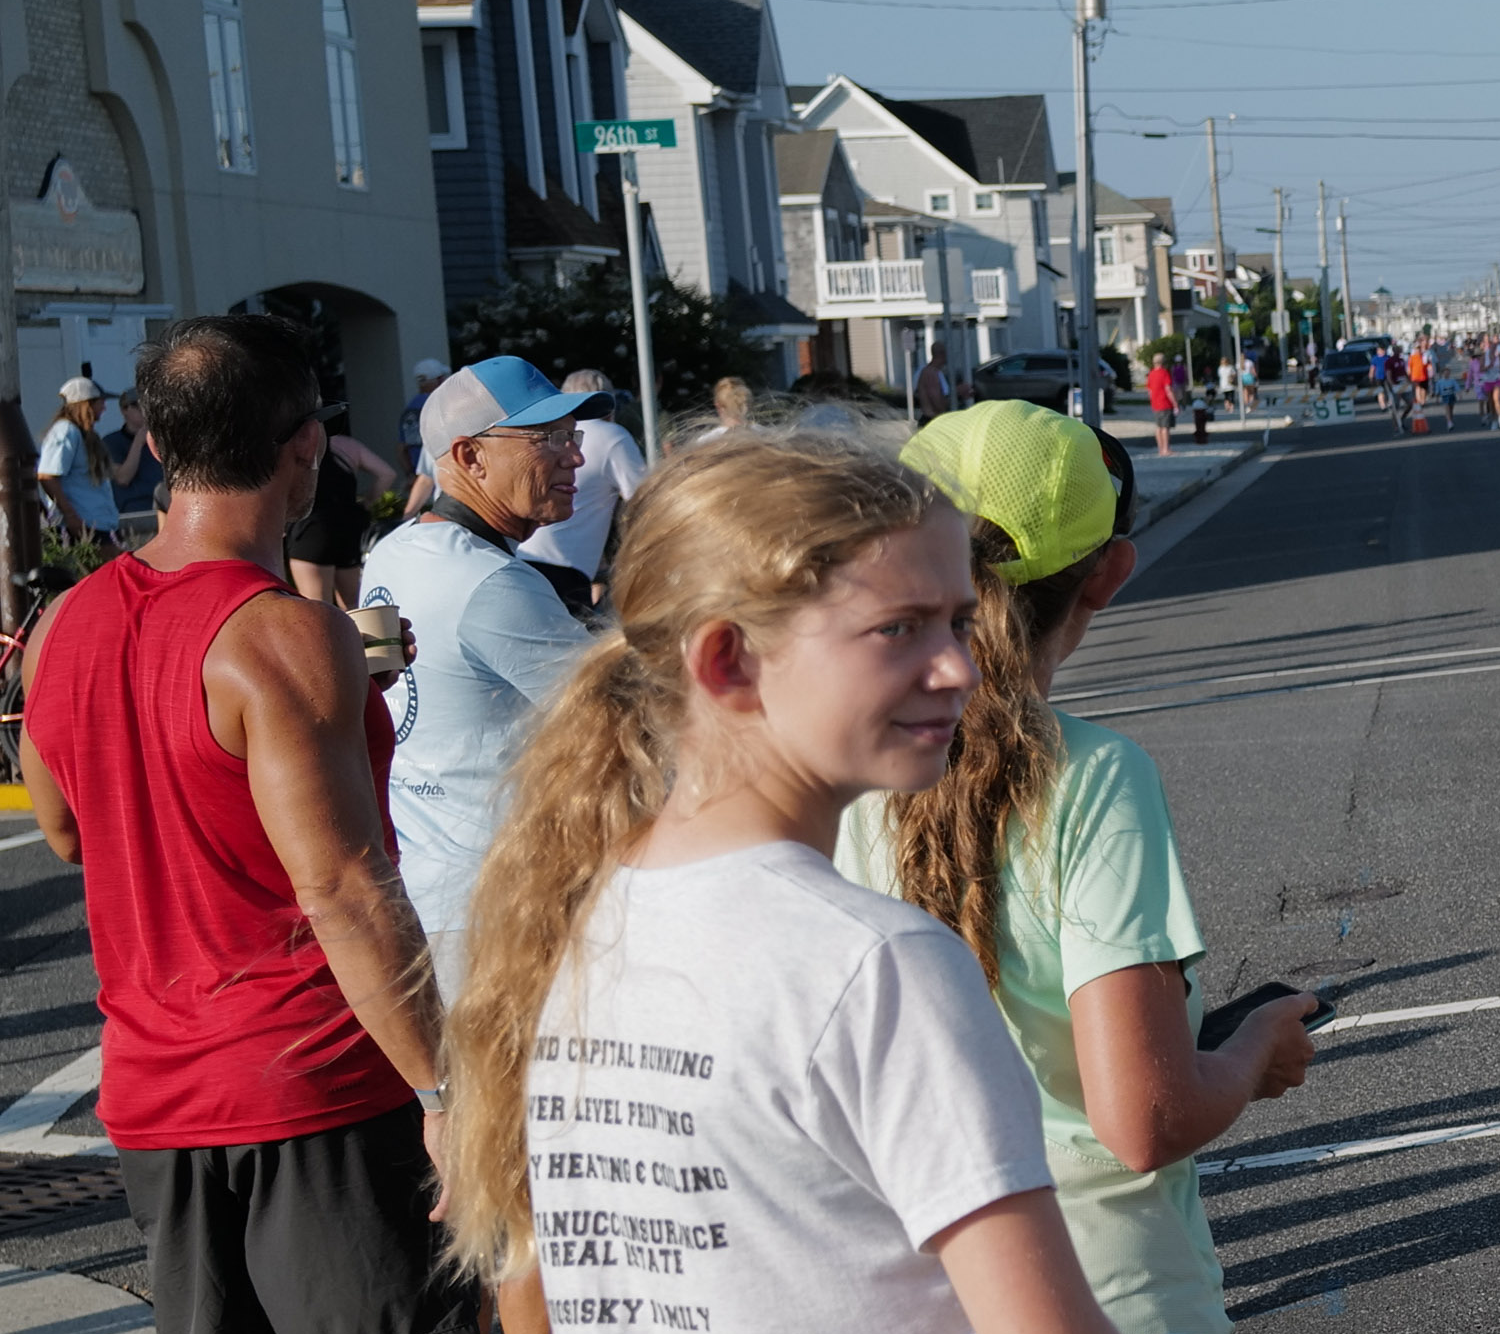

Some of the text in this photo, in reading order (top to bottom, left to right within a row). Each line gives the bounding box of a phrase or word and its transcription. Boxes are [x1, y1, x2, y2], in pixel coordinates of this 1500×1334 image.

[594, 124, 638, 147] 96th
[396, 666, 416, 742] ASSOCIATIO
[567, 1037, 636, 1068] CAPITAL
[639, 1044, 715, 1080] RUNNING
[574, 1096, 623, 1125] LEVEL
[627, 1101, 696, 1137] PRINTING
[548, 1153, 632, 1184] HEATING
[652, 1161, 729, 1193] COOLING
[623, 1214, 729, 1251] INSURANCE
[551, 1240, 618, 1267] REAL
[624, 1241, 685, 1275] ESTATE
